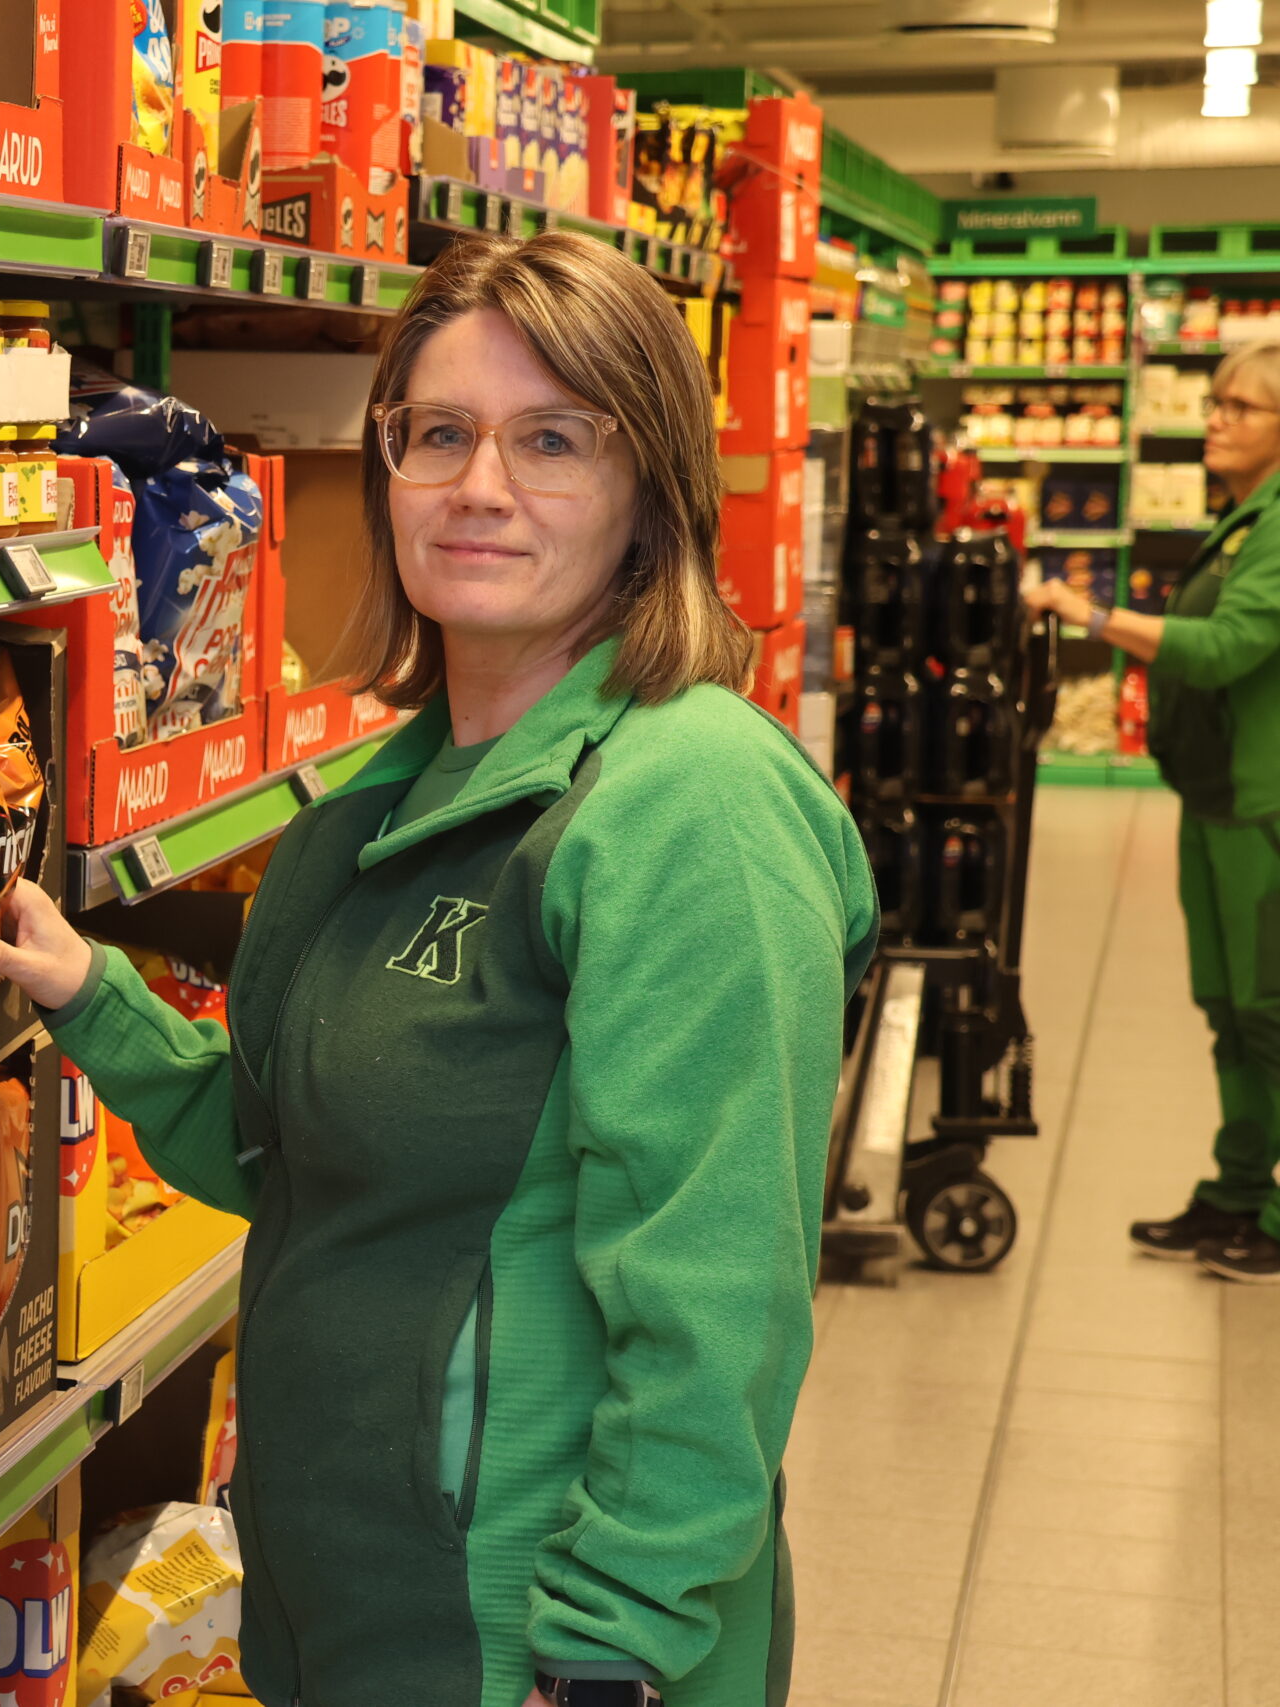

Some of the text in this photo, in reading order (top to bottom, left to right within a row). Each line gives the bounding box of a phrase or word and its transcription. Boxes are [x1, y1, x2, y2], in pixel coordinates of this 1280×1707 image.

[262, 200, 306, 239] GLES
[282, 702, 327, 763] MAARUD
[115, 762, 169, 831] MAARUD
[198, 735, 246, 800] MAARUD
[385, 894, 490, 986] K
[60, 1076, 95, 1145] LW
[18, 1285, 54, 1338] NACHO
[13, 1327, 53, 1377] CHEESE
[14, 1358, 52, 1407] FLAVOUR
